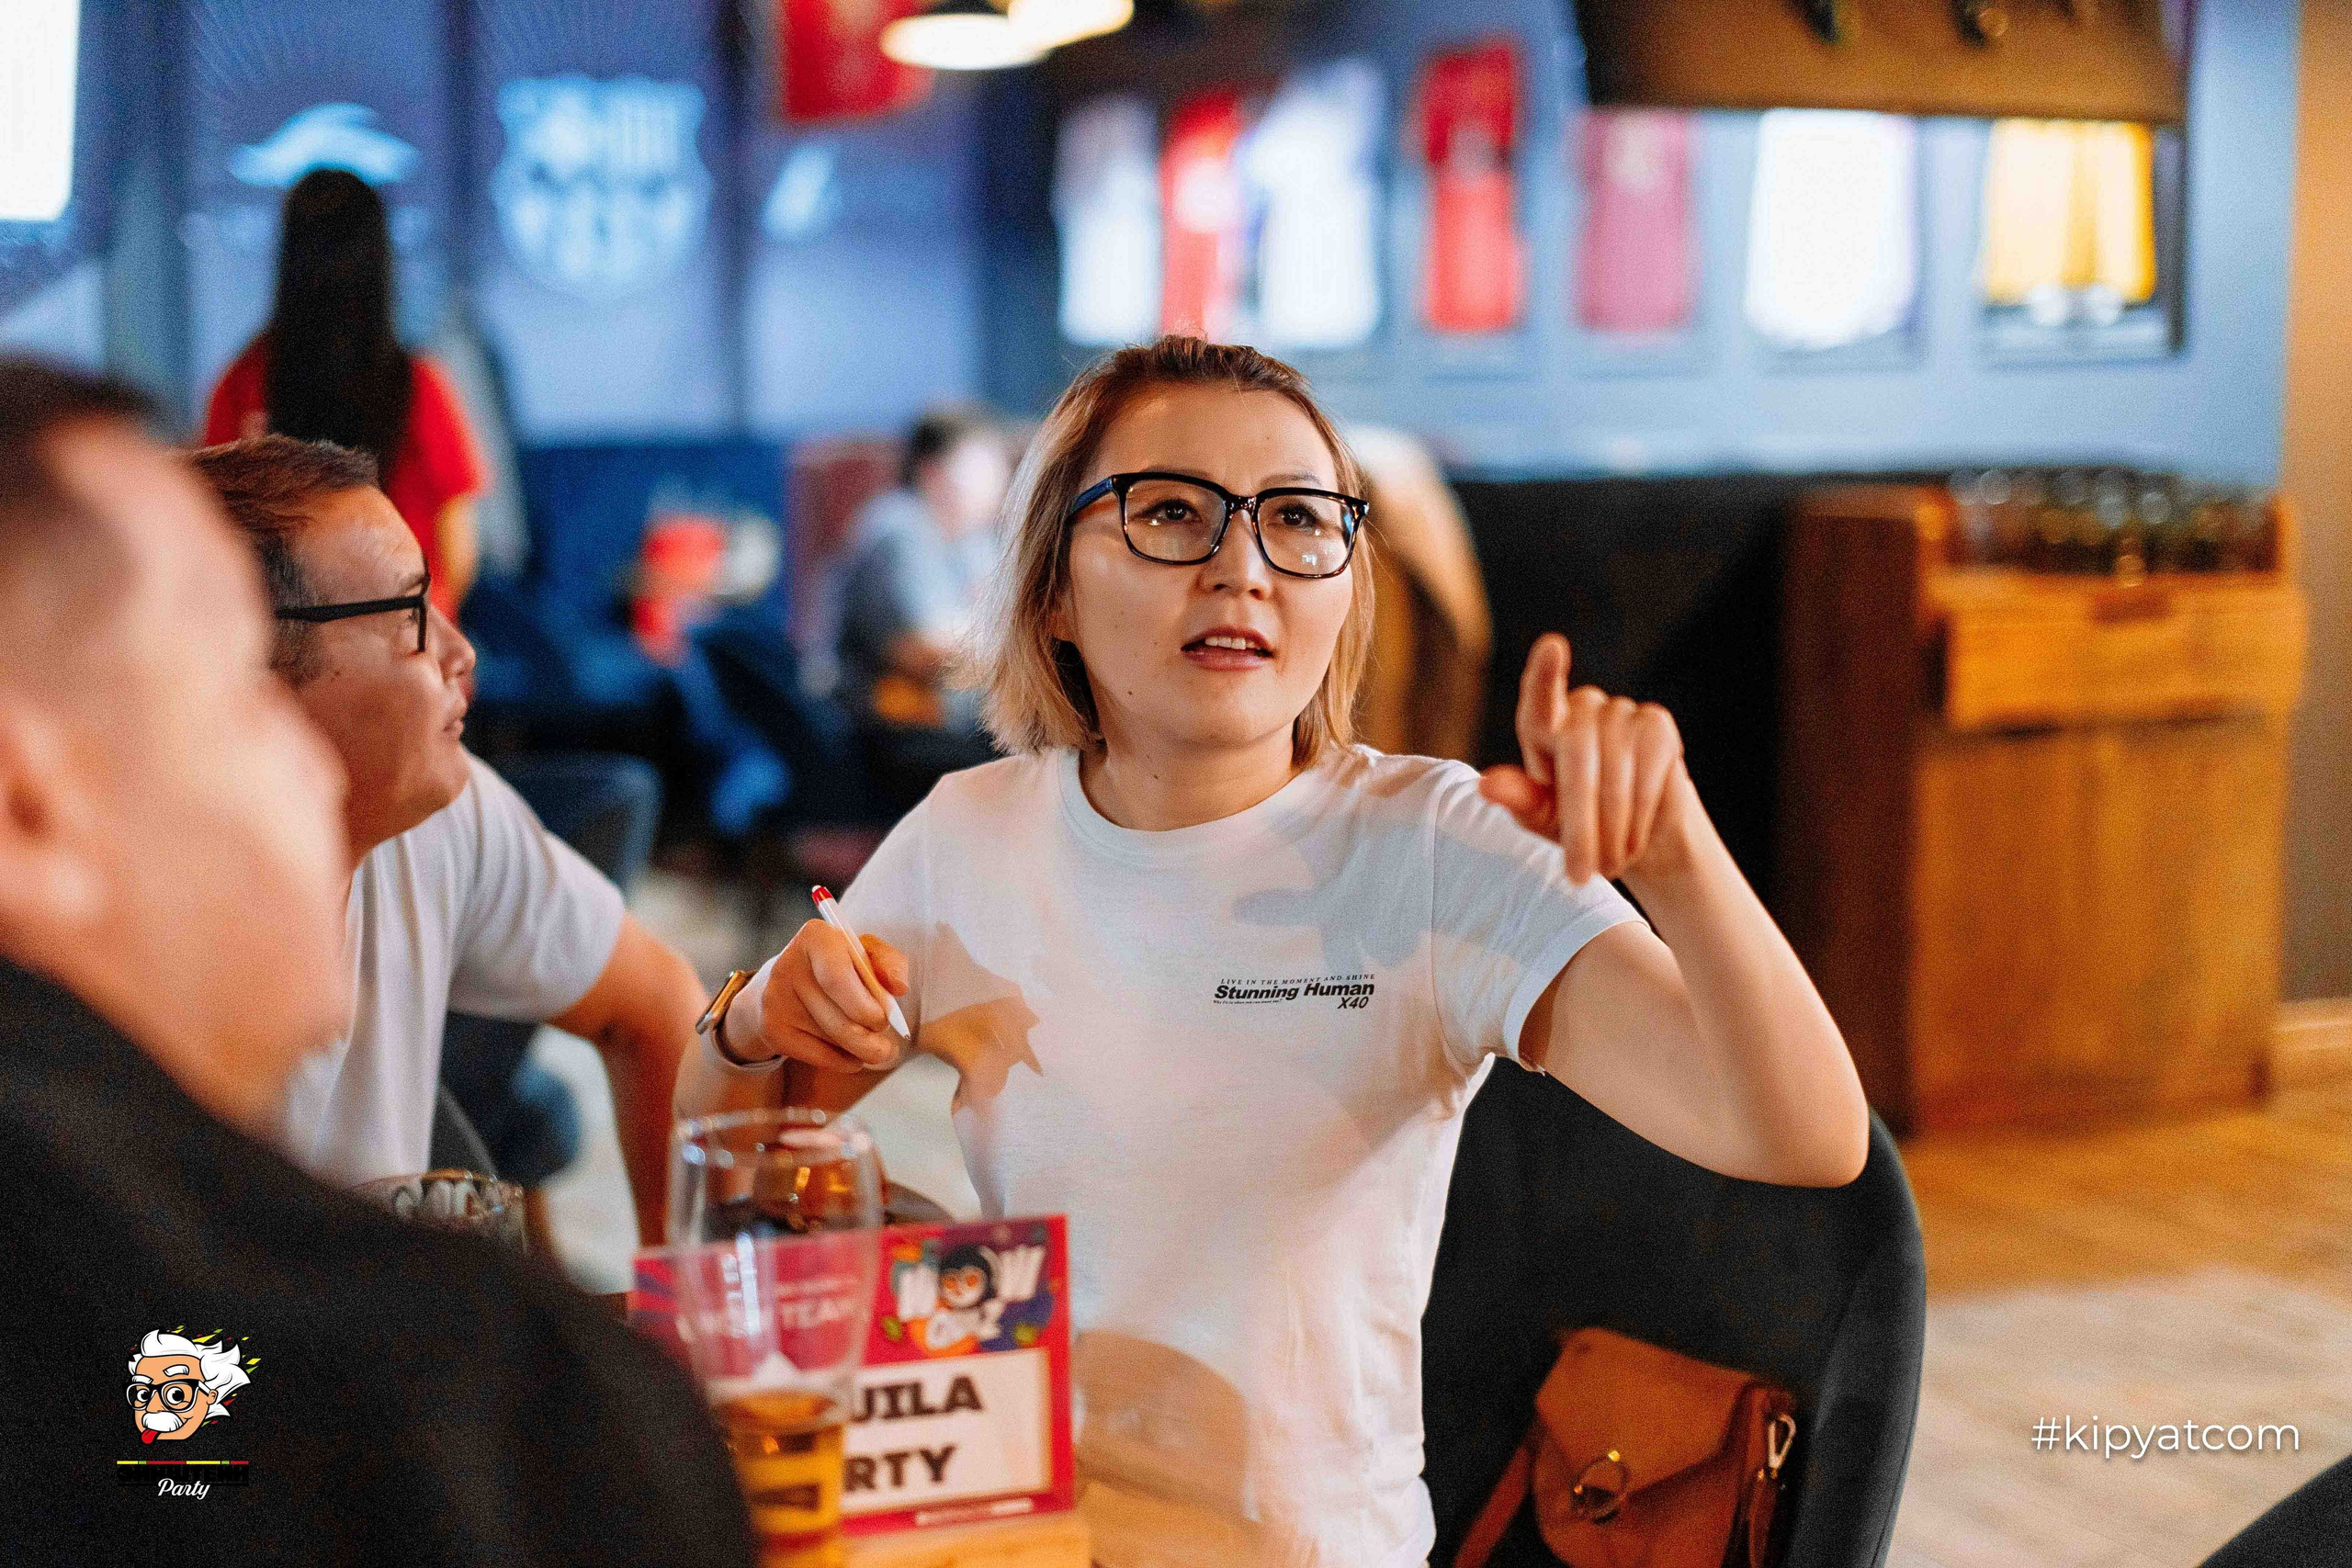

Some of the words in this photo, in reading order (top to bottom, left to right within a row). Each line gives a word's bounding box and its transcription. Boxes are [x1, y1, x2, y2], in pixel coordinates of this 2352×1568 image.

[1215, 985, 1300, 1000] Stunning
[1304, 982, 1374, 997] Human
[1337, 997, 1369, 1009] X40
[842, 1444, 956, 1493] RTY
